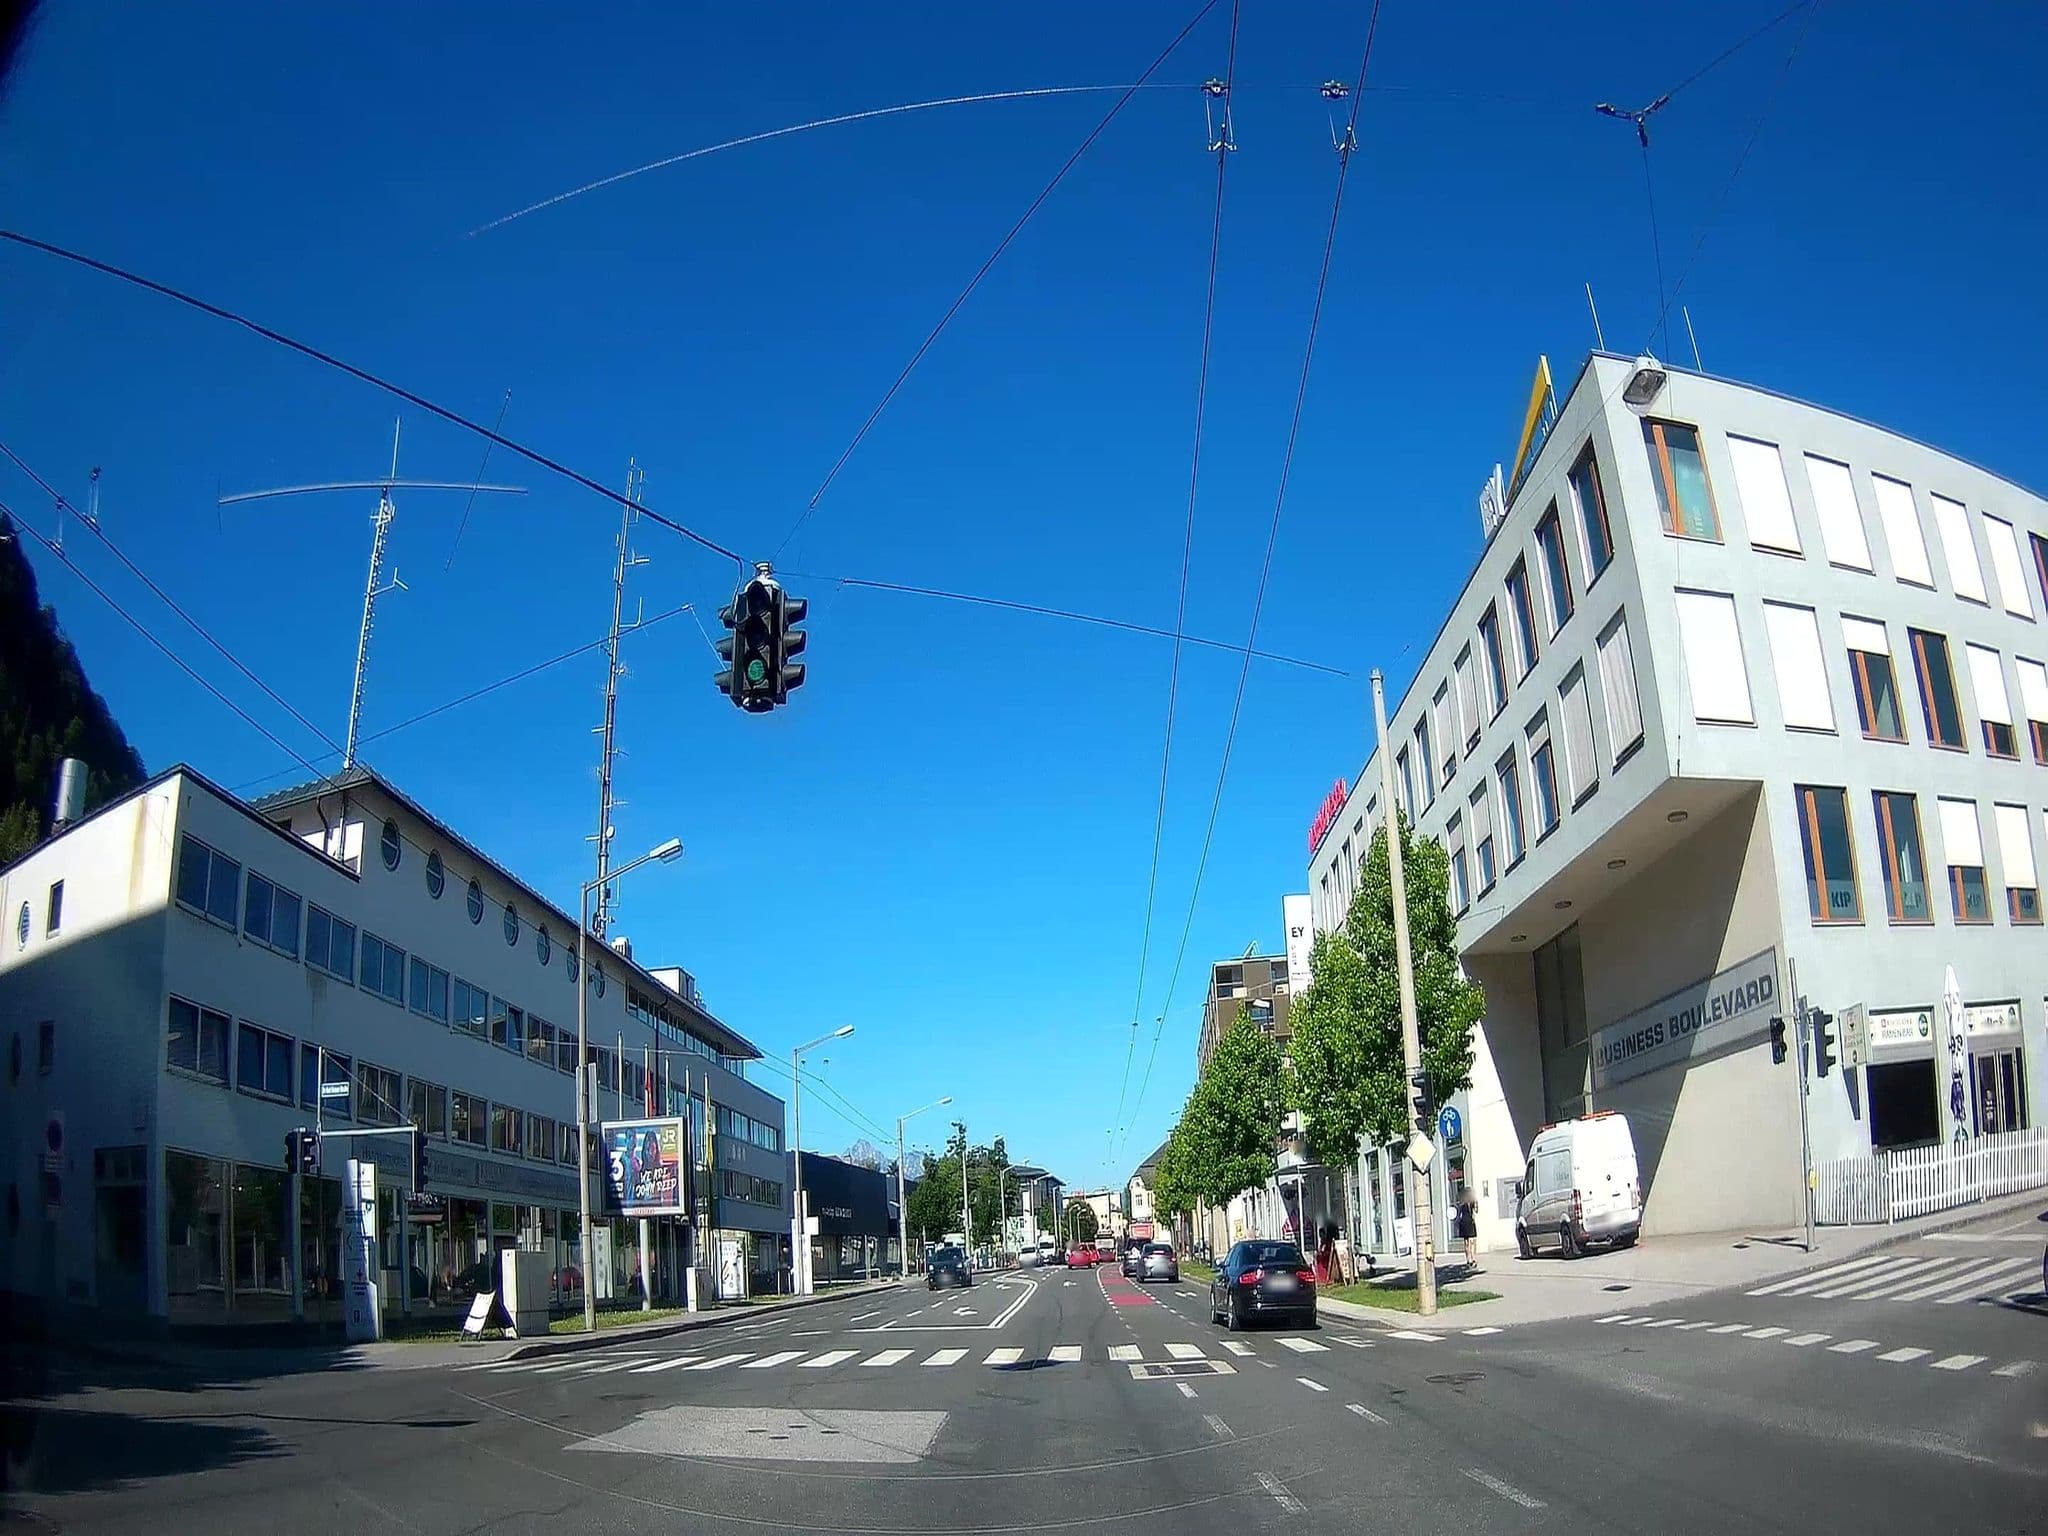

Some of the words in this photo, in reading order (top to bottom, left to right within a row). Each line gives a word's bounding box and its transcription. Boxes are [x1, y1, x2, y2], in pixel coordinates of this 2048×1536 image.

[1831, 891, 1851, 908] KIP
[1291, 926, 1305, 938] EY
[1595, 1022, 1665, 1068] BUSINESS
[1668, 974, 1773, 1038] BOULEVARD
[662, 1129, 676, 1143] JR
